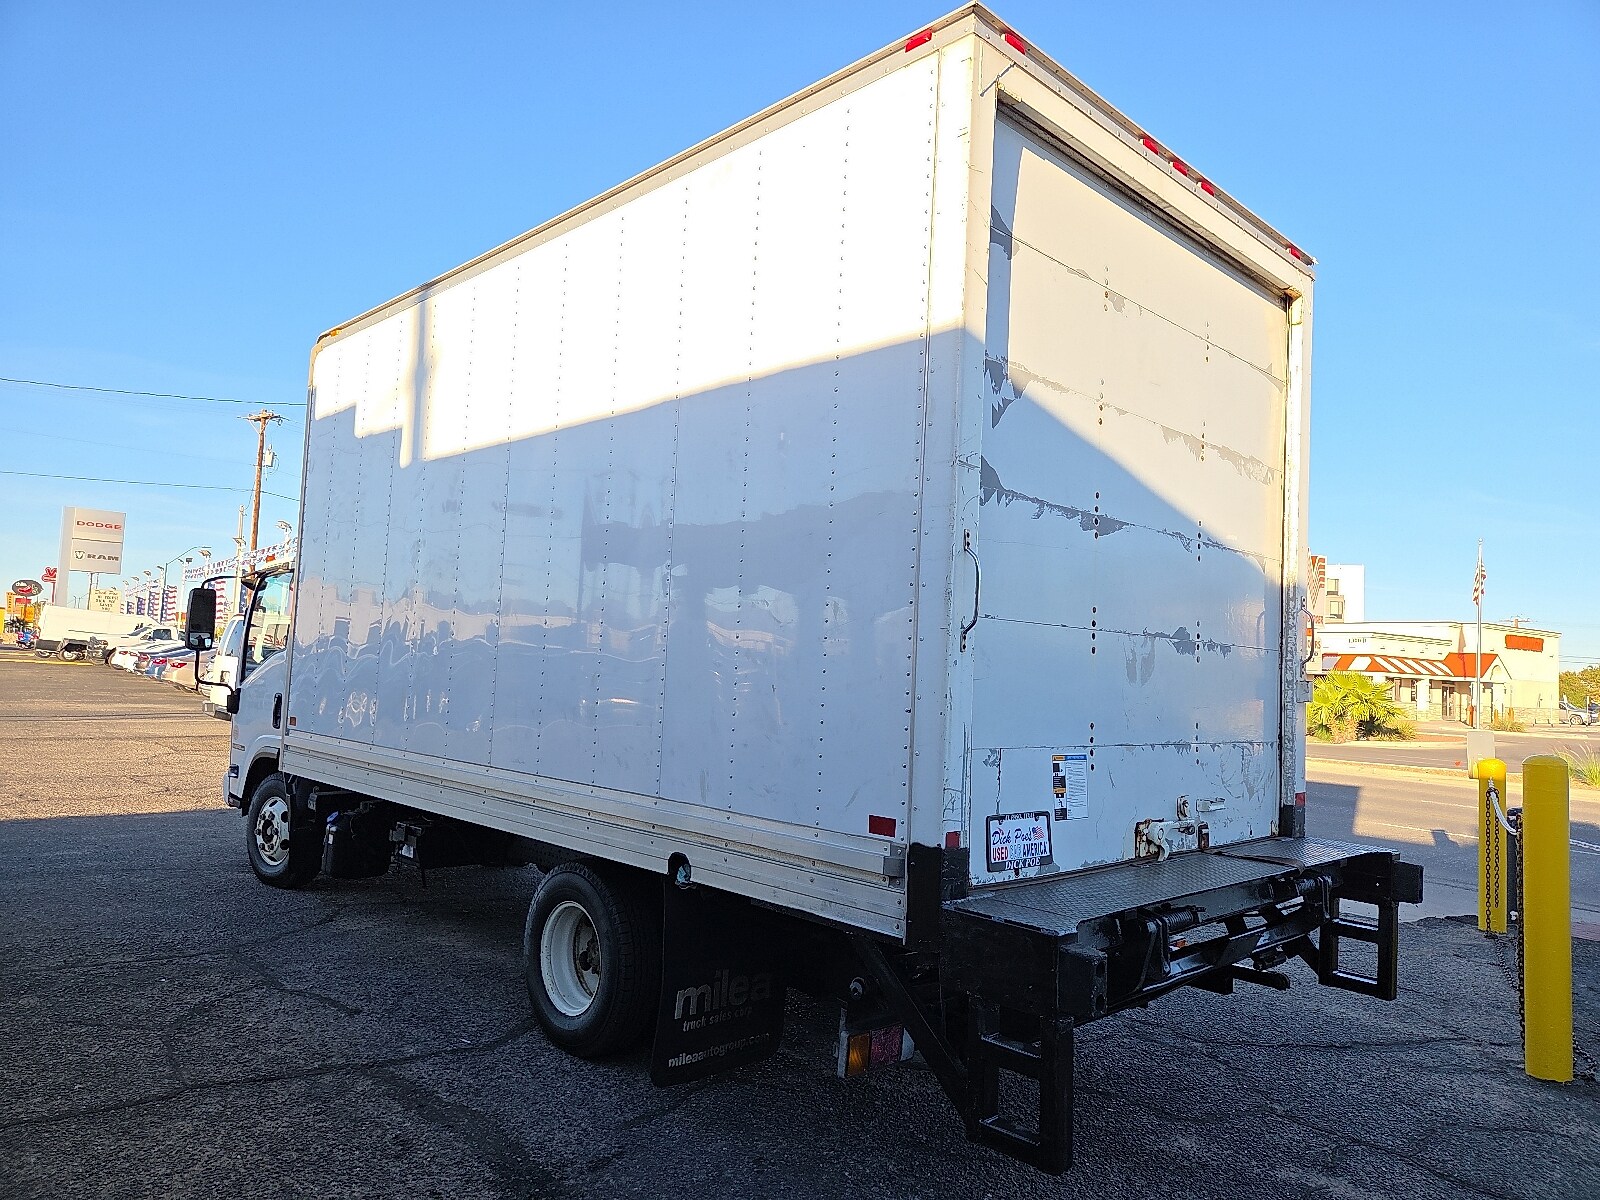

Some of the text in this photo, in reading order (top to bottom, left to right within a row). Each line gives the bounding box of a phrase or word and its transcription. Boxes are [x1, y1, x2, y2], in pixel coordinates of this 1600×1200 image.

[76, 520, 122, 530] DODGE
[87, 553, 119, 561] RAM
[992, 829, 1011, 845] Dick
[992, 846, 1008, 861] USED
[1022, 841, 1048, 857] AMERICA
[1005, 857, 1041, 870] DICK POE
[674, 968, 772, 1020] milea
[682, 1016, 707, 1033] truck
[709, 1010, 732, 1025] sales
[668, 1032, 770, 1068] mileaautogroup.com
